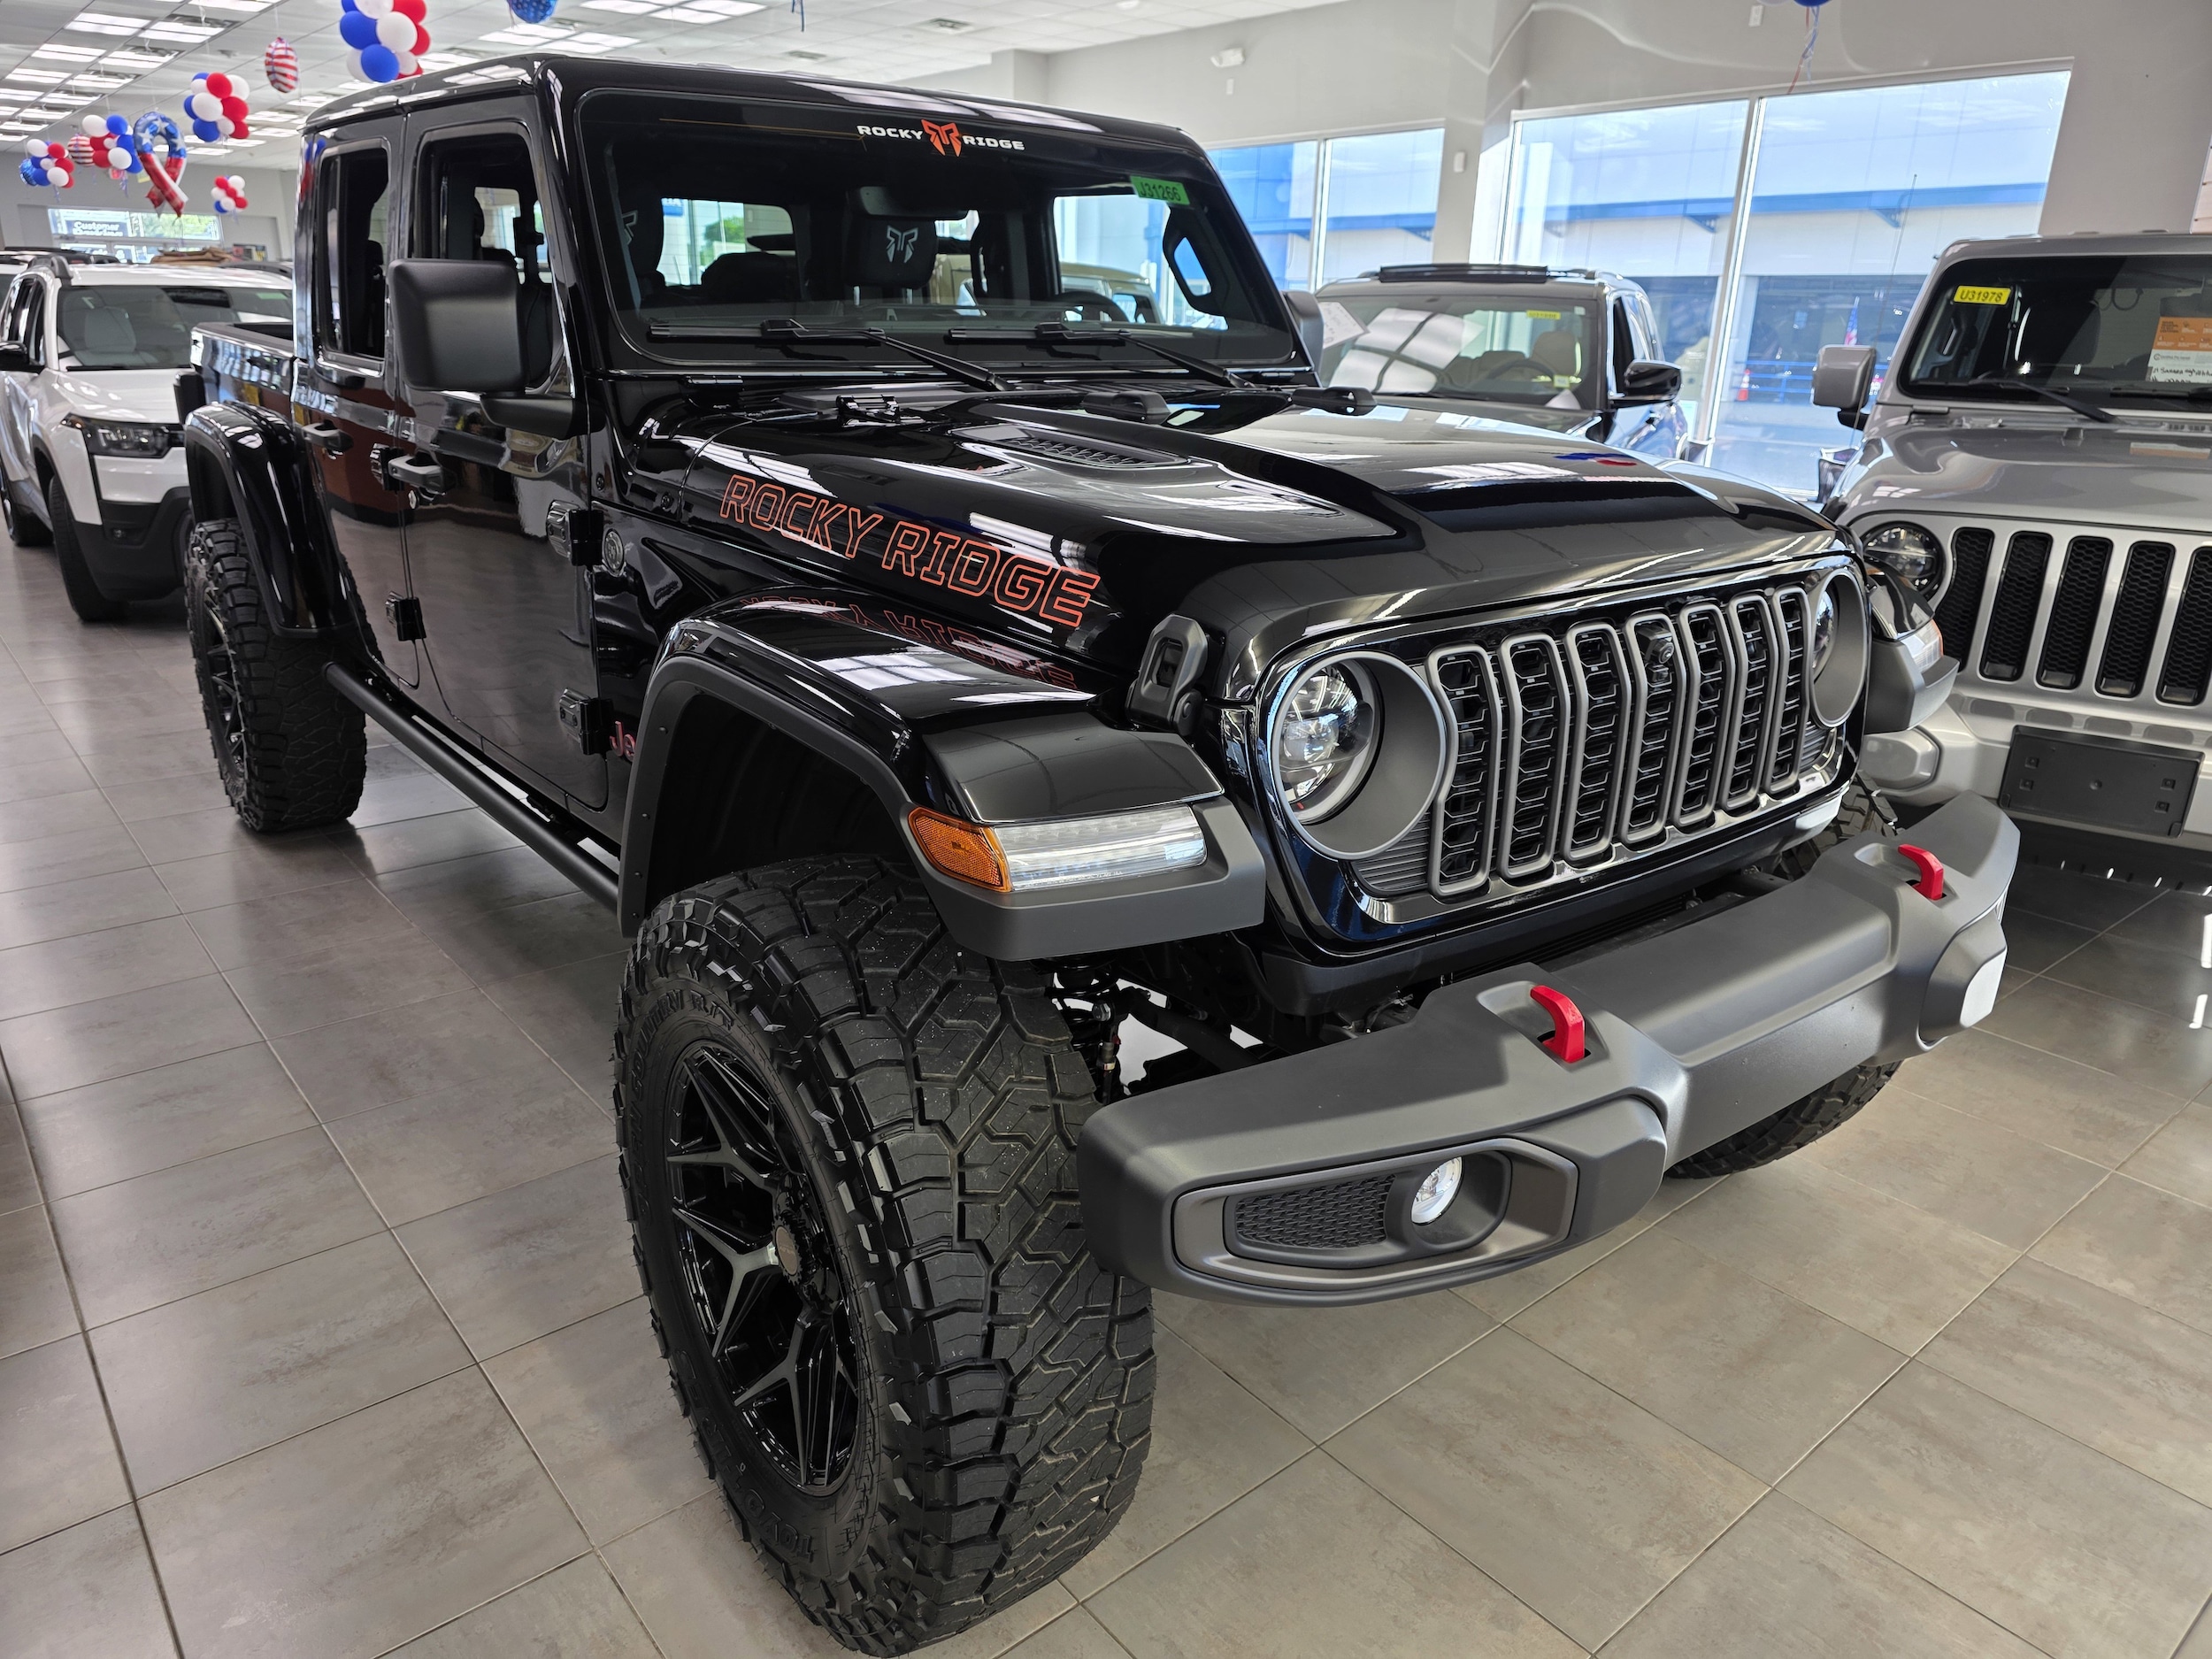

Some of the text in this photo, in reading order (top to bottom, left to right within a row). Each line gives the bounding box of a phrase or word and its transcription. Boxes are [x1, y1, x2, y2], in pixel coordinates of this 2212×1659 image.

[856, 125, 1025, 151] ROCKY RIDGE
[1140, 181, 1181, 202] J31266
[73, 221, 119, 231] Customer
[1959, 288, 2003, 303] U31978
[719, 473, 1102, 627] ROCKY RIDGE
[631, 988, 685, 1102] COUNTRY
[742, 1486, 815, 1563] TOYO
